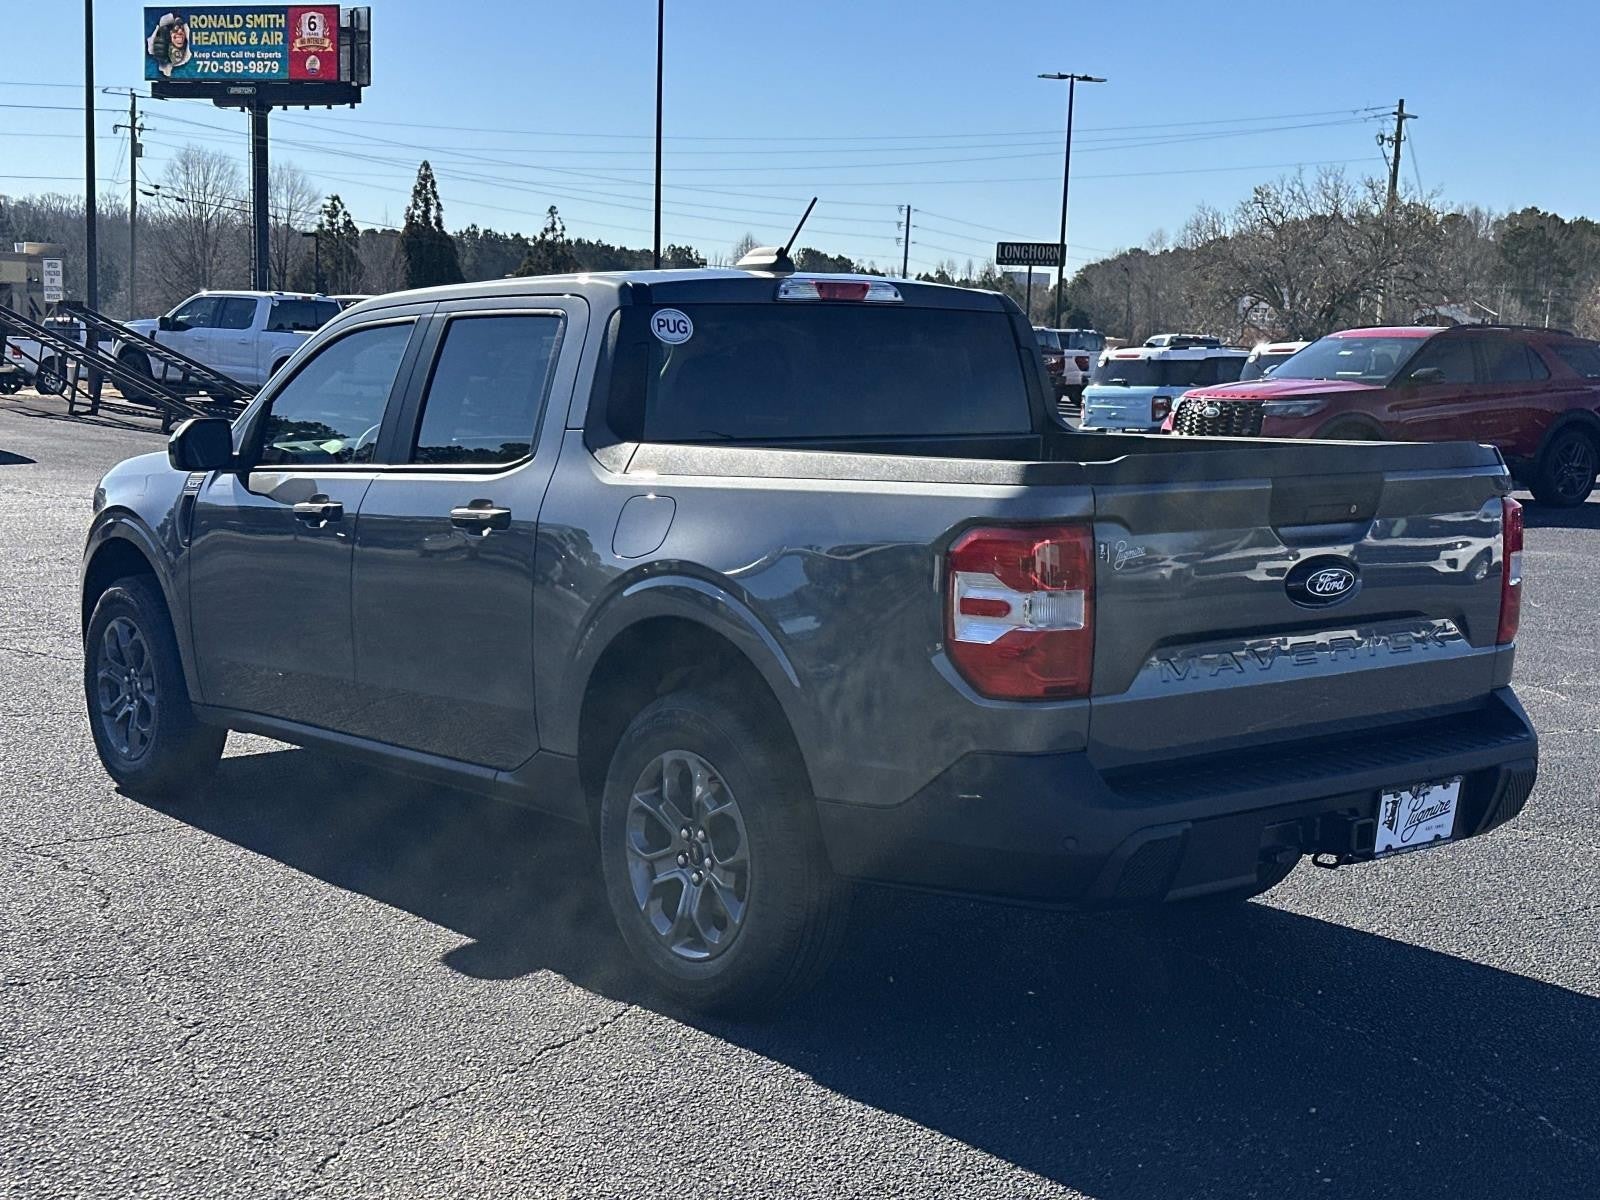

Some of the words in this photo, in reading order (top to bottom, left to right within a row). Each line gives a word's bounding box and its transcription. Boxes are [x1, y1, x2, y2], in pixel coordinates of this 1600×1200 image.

[189, 15, 243, 29] RONALD
[245, 14, 285, 28] SMITH
[307, 15, 317, 31] 6
[192, 31, 246, 46] HEATING
[249, 32, 258, 45] &
[261, 31, 283, 45] AIR
[193, 51, 210, 59] Keep
[211, 51, 230, 59] Calm,
[230, 51, 244, 59] Call
[245, 51, 256, 59] the
[256, 51, 281, 59] Experts
[196, 60, 279, 73] 770-819-9879
[998, 244, 1060, 259] LONGHORN
[656, 318, 688, 334] PUG
[1316, 573, 1346, 592] Ford
[1160, 619, 1454, 683] MAVERICK
[1401, 791, 1451, 843] Pugmire
